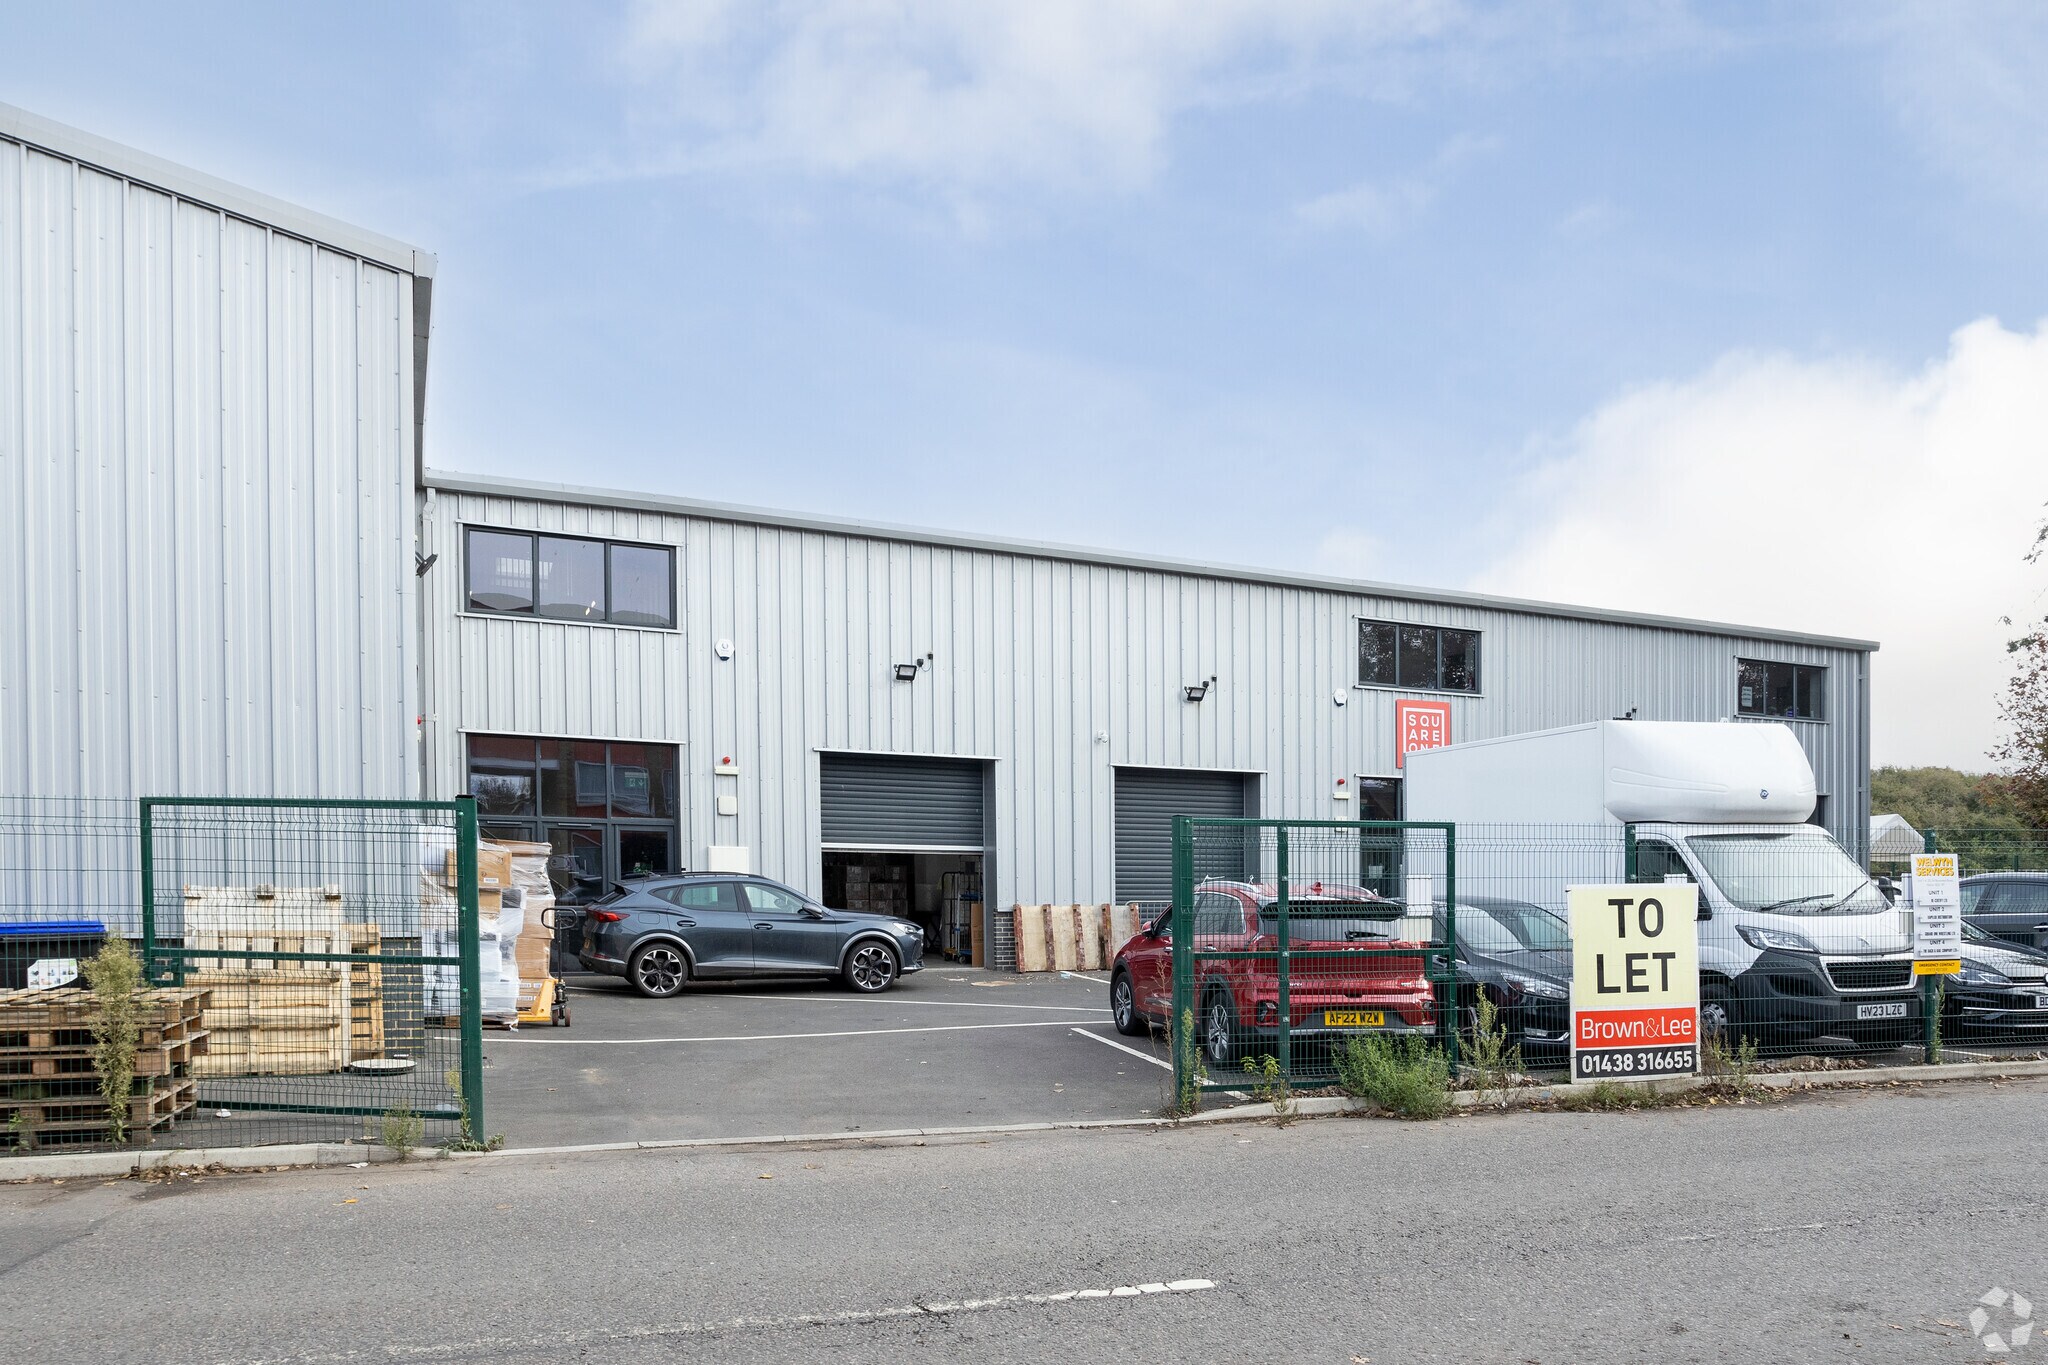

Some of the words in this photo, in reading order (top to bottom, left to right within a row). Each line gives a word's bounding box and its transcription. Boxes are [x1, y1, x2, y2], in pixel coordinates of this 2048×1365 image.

[1408, 714, 1440, 727] SQU
[1408, 729, 1440, 741] ARE
[1916, 857, 1954, 867] WELWYN
[1916, 867, 1955, 877] SERVICES
[1607, 897, 1664, 938] TO
[1596, 951, 1676, 994] LET
[1860, 1005, 1884, 1017] HV23
[1885, 1004, 1903, 1016] LZC
[1329, 1012, 1357, 1023] AF22
[1581, 1015, 1692, 1040] Brown&Lee
[1581, 1053, 1634, 1073] 01438
[1637, 1050, 1693, 1071] 316655
